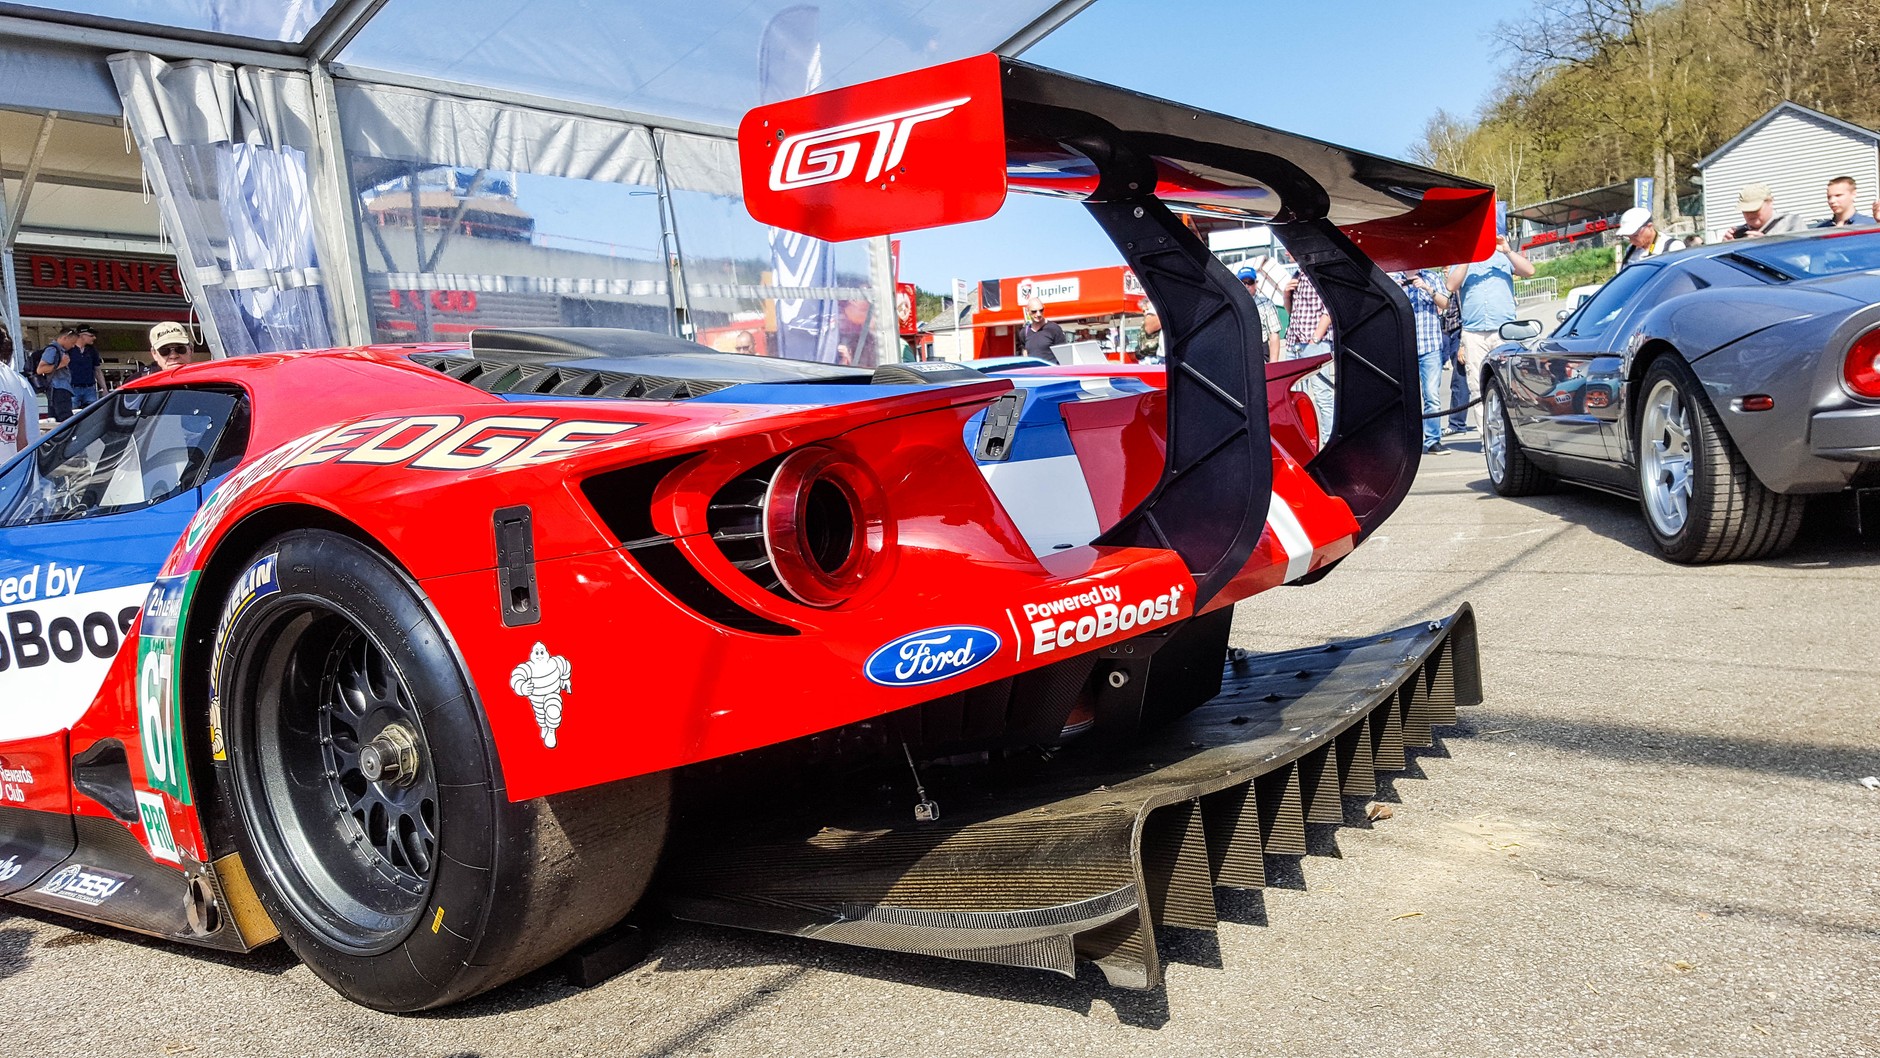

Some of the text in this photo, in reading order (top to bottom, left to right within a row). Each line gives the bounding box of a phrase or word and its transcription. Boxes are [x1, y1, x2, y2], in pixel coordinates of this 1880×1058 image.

[769, 97, 971, 191] GT
[1037, 284, 1073, 298] Jupiler
[281, 415, 647, 470] EDGE
[45, 562, 85, 596] by
[1023, 585, 1122, 621] Powered by
[1031, 585, 1184, 655] EcoBoost
[895, 634, 976, 680] Ford
[141, 650, 177, 786] 67
[5, 783, 25, 803] Club
[141, 803, 176, 853] PRO
